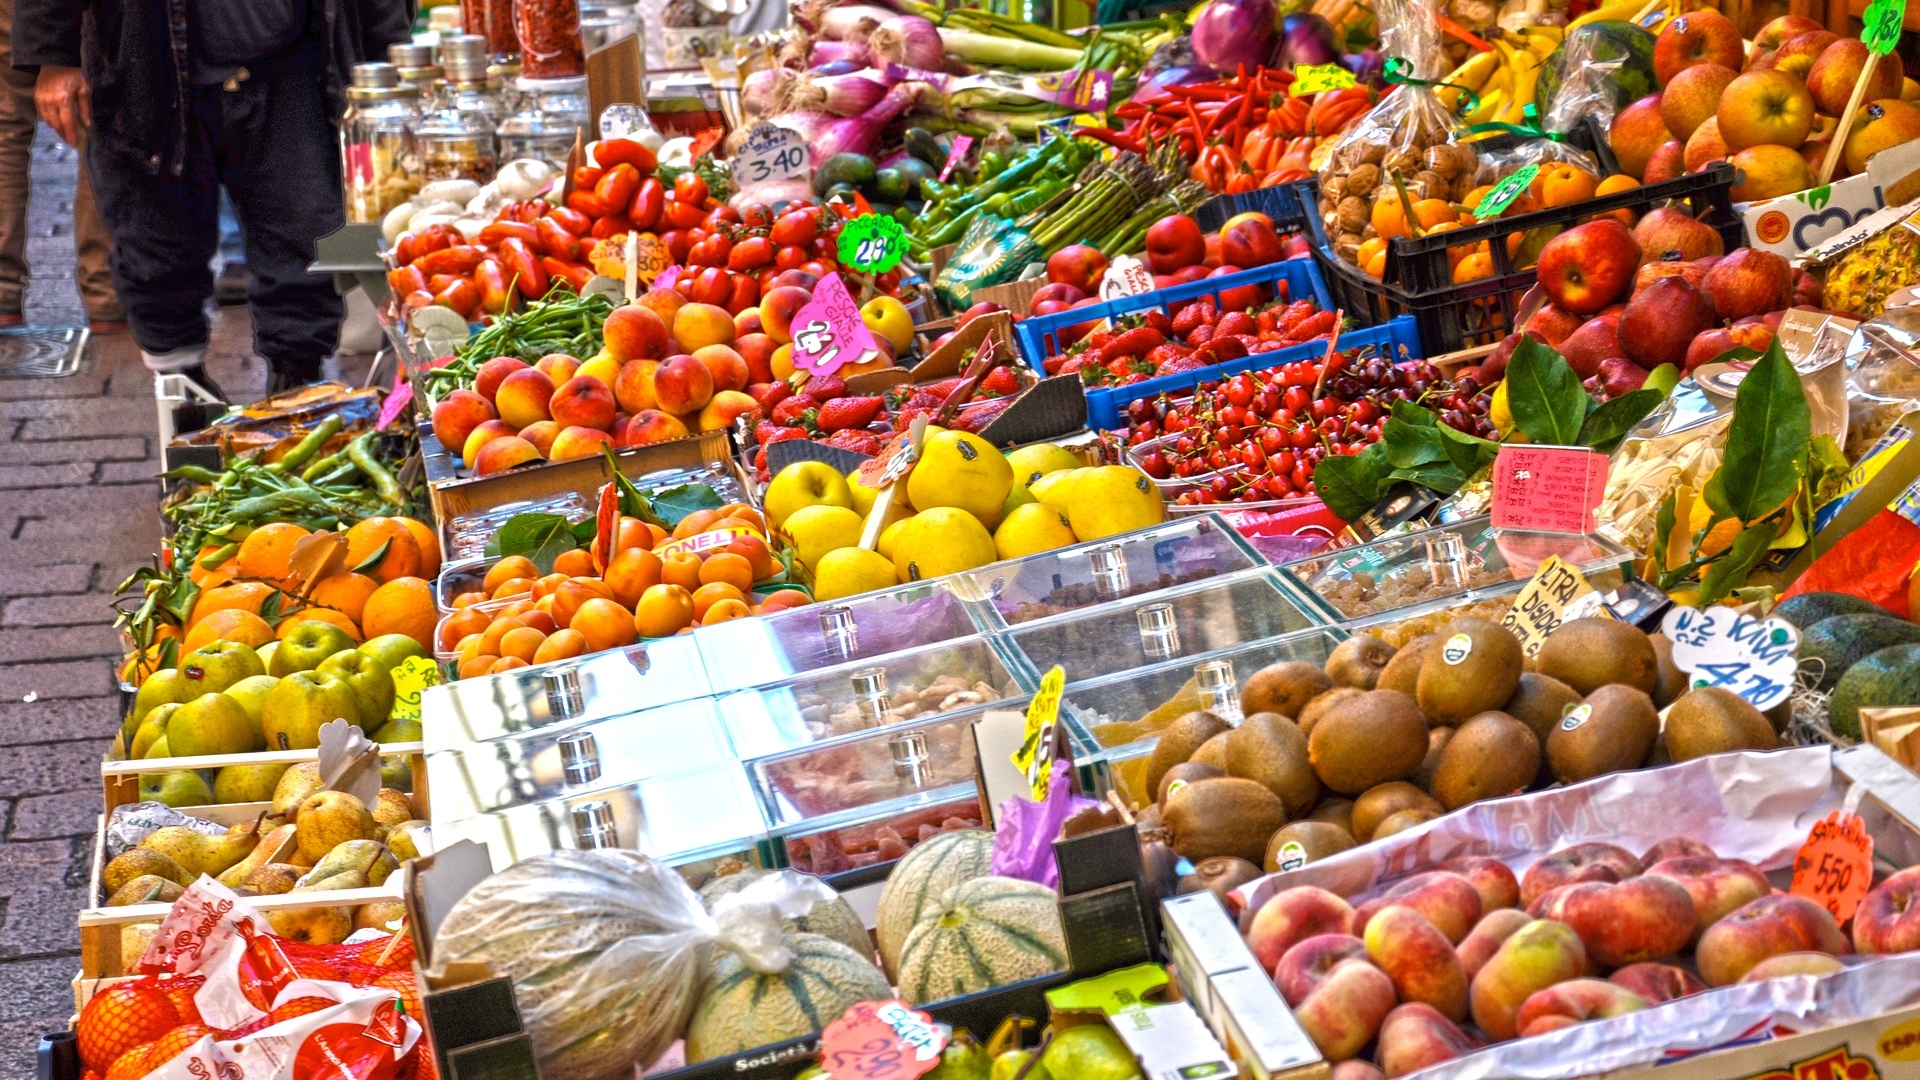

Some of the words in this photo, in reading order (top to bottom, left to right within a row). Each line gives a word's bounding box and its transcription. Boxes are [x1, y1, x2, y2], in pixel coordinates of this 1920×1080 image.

[749, 146, 804, 182] 3.40
[826, 280, 862, 333] PESCHE
[824, 305, 854, 349] GIALLE
[735, 1043, 809, 1073] Società
